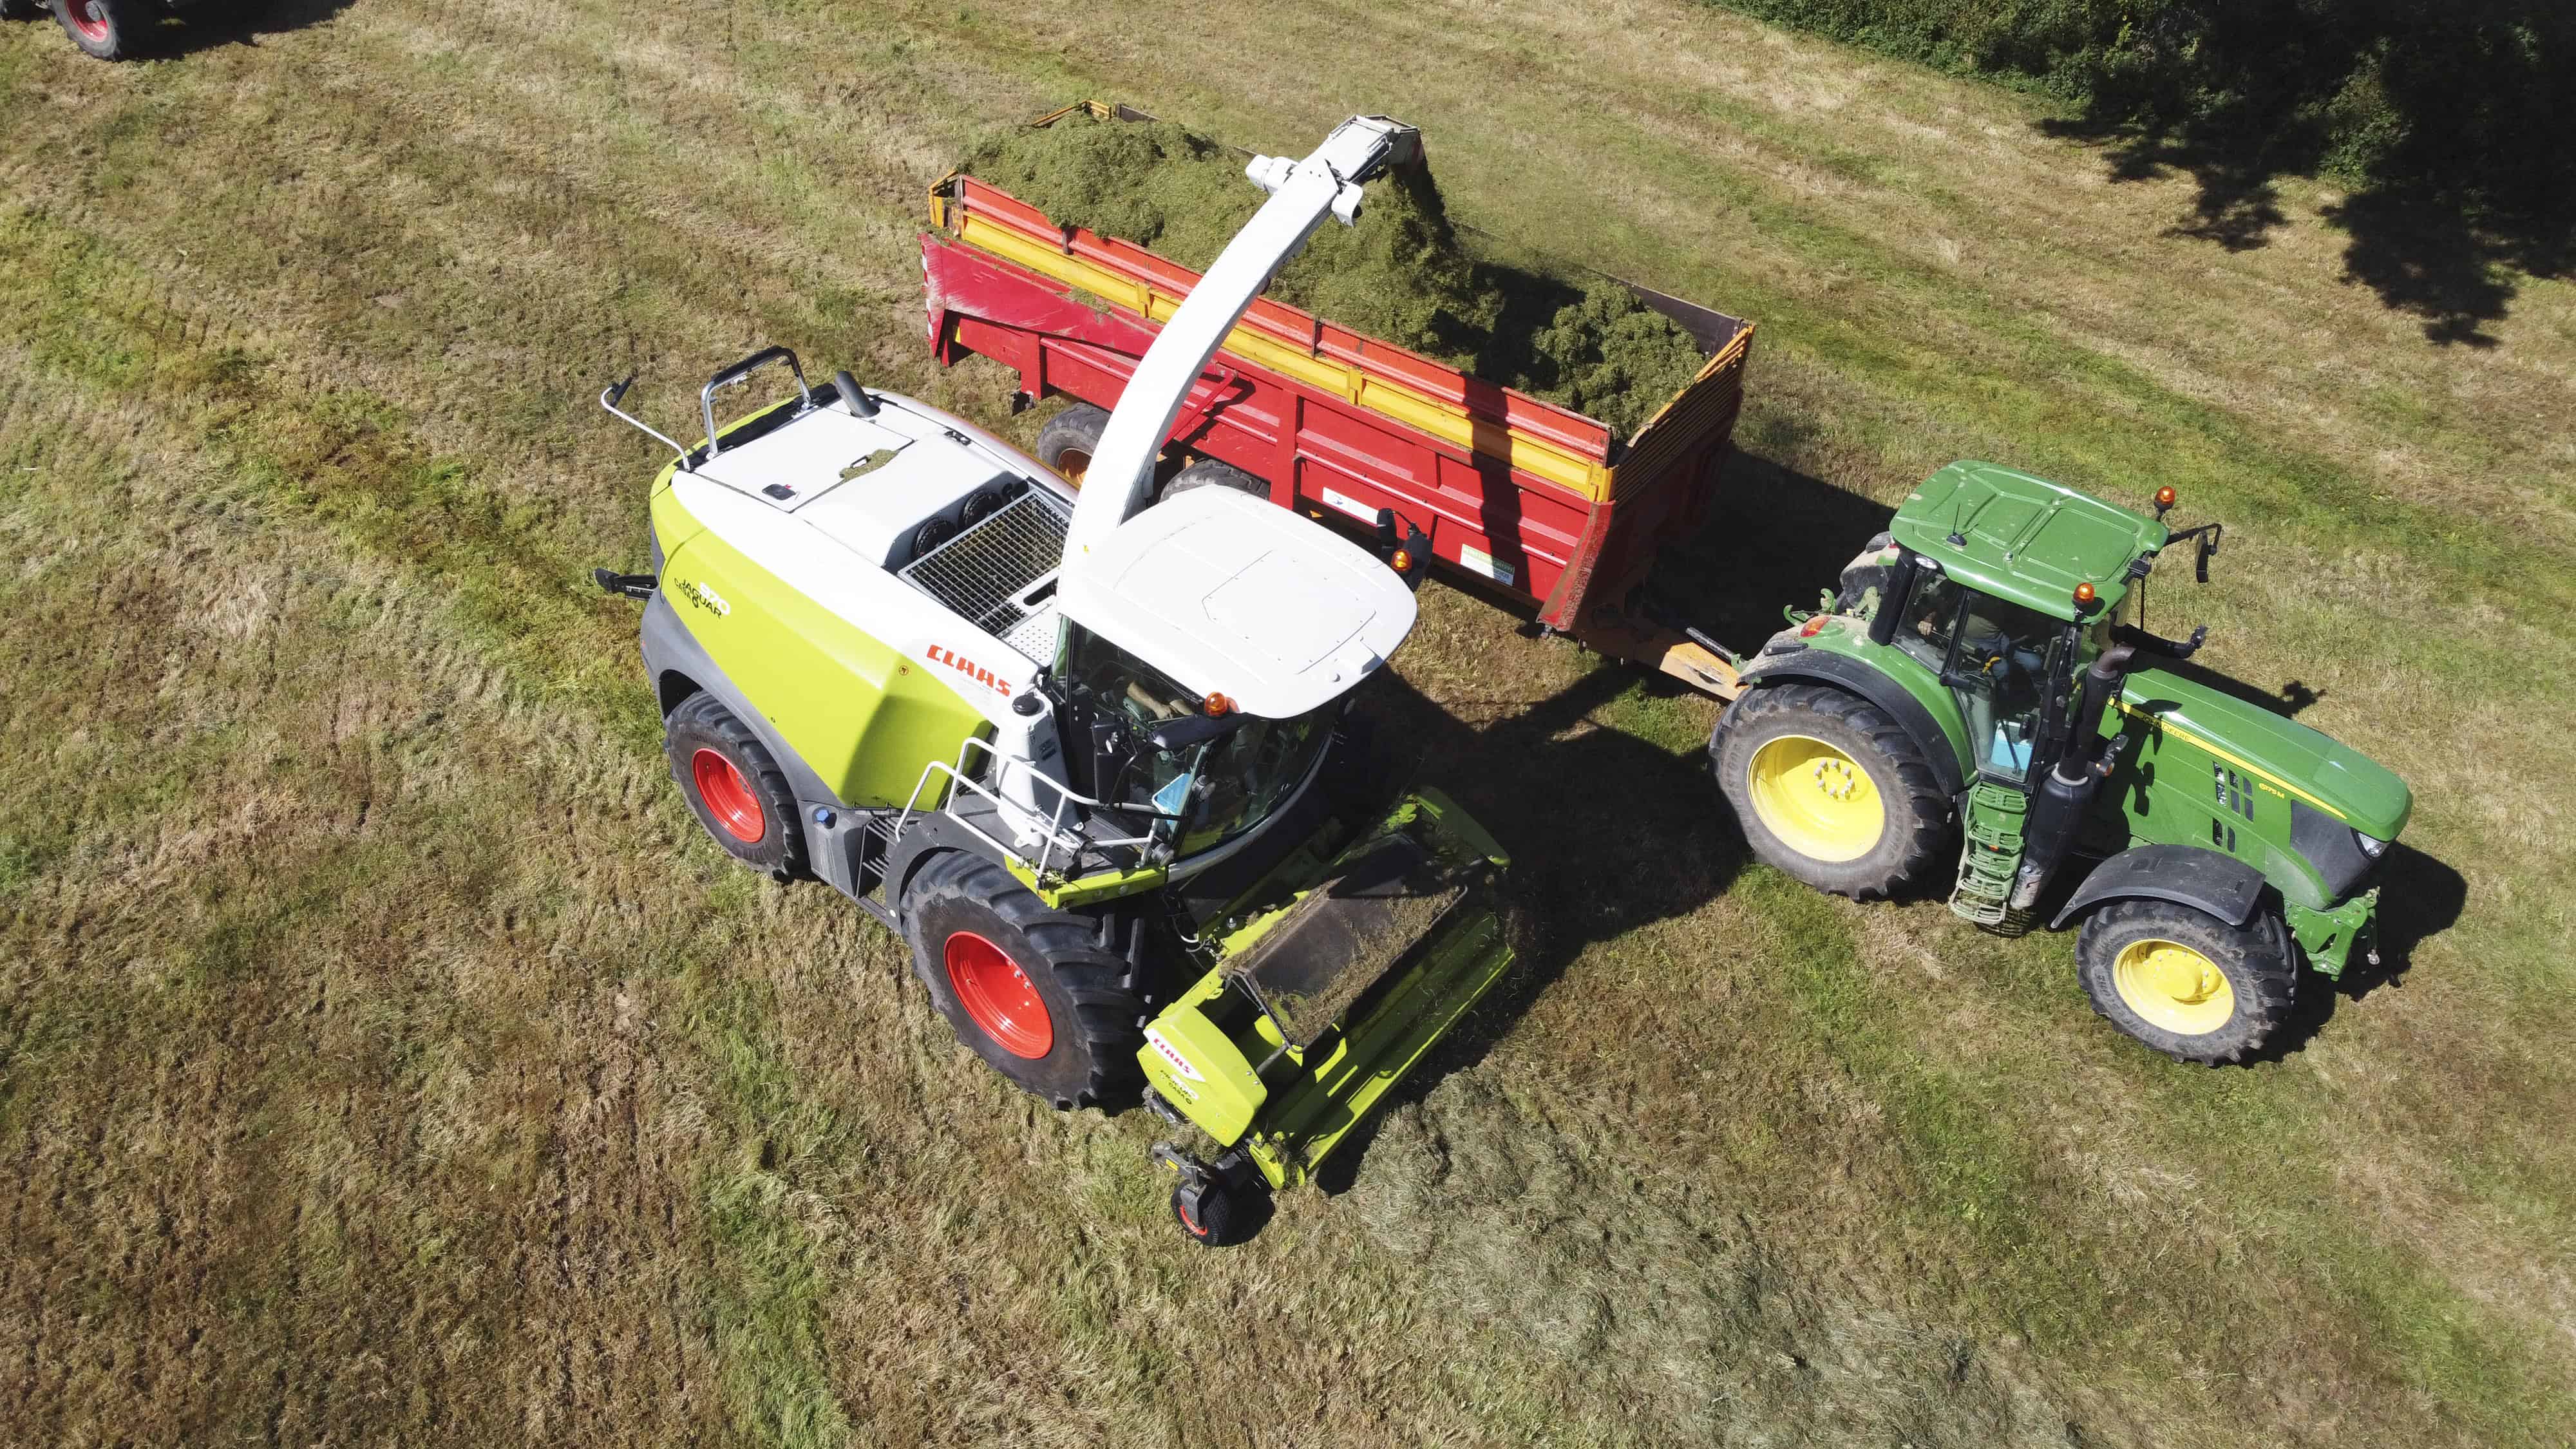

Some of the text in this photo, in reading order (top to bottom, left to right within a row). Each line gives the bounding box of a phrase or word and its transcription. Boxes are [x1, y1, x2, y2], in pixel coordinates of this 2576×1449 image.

[682, 579, 721, 619] JAGUAR
[700, 582, 730, 615] 970
[927, 644, 1011, 697] CLAAS
[2163, 724, 2190, 741] DEERE
[1153, 1038, 1191, 1074] CLAAS
